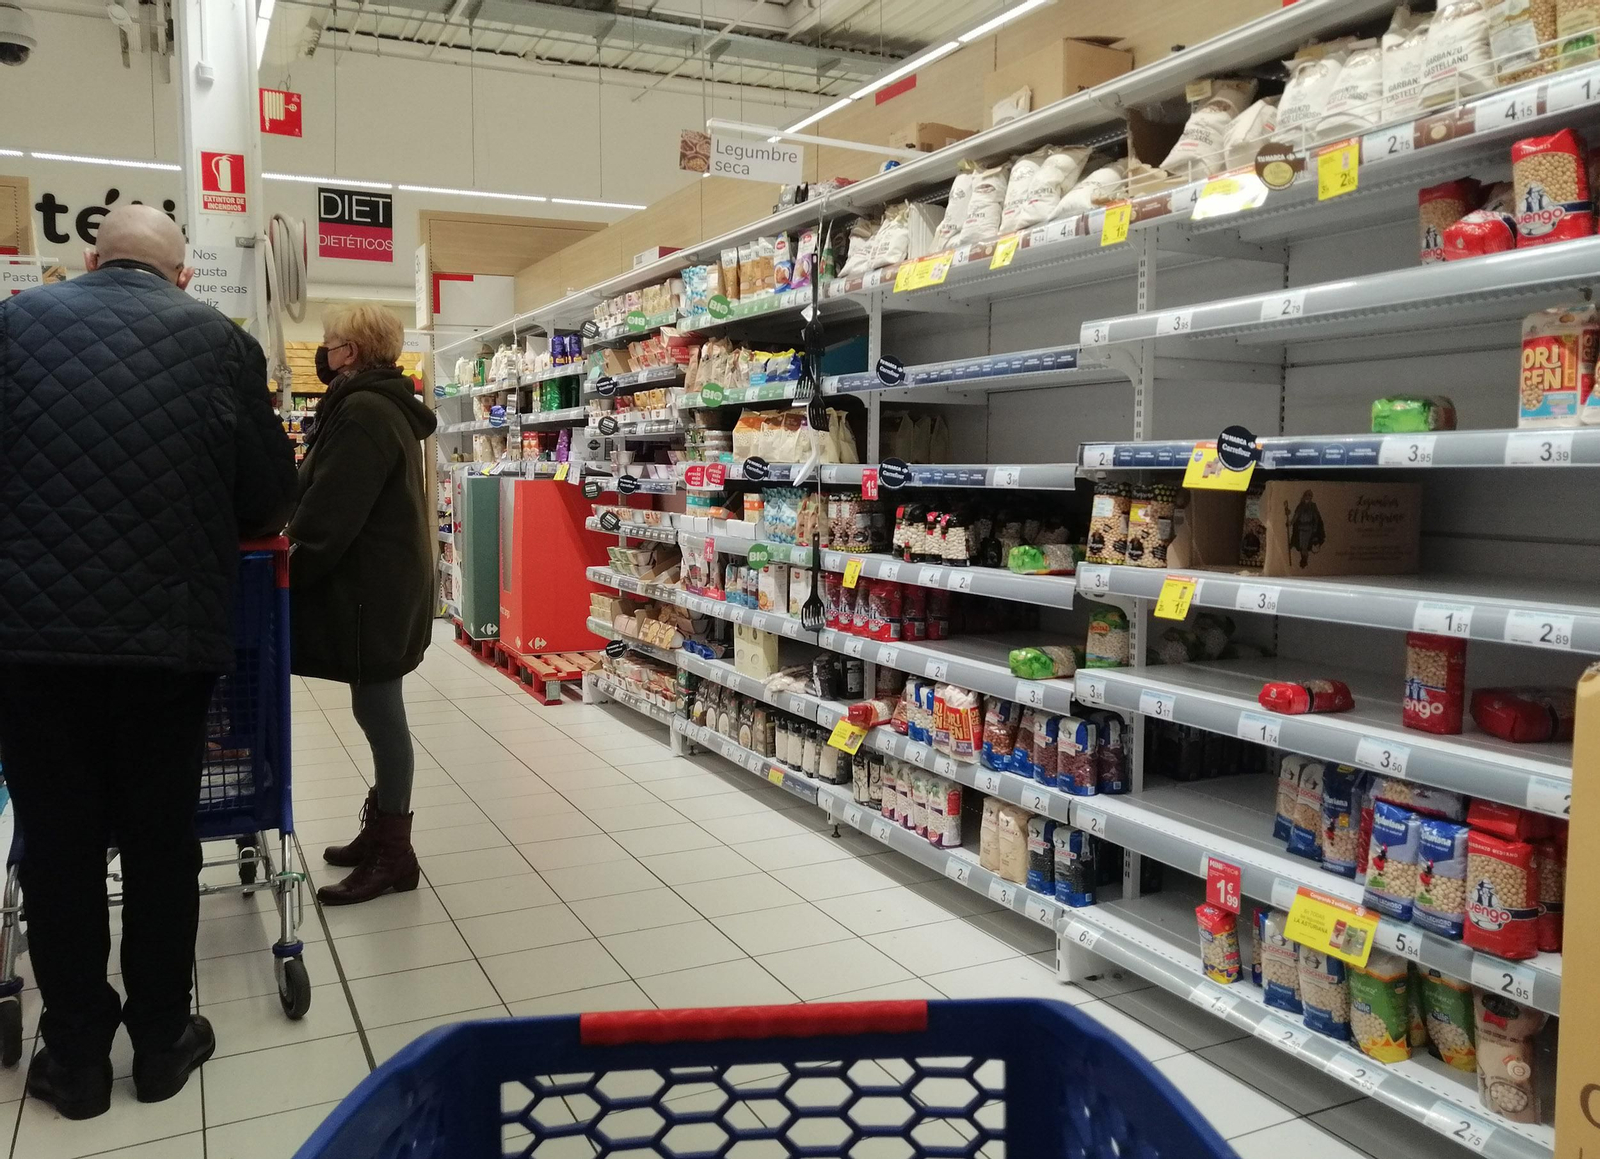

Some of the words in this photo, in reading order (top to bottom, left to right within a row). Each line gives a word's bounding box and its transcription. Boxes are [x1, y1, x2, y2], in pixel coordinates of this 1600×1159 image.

[716, 139, 798, 163] Legumbre
[714, 160, 750, 175] seca
[203, 195, 236, 204] EXTINTOR
[236, 197, 245, 205] DE
[207, 202, 242, 211] INCENDIOS
[319, 191, 391, 223] DIET
[318, 231, 394, 252] DIETÉTICOS
[192, 249, 218, 261] Nos
[2, 271, 39, 283] Pasta
[193, 267, 228, 278] gusta
[194, 284, 218, 293] que
[220, 285, 248, 294] seas
[708, 300, 729, 314] BIO
[1281, 299, 1301, 316] 2,79
[1523, 345, 1562, 369] ORI
[702, 389, 722, 400] BIO
[1228, 434, 1247, 446] MARCA
[1221, 443, 1253, 458] Carrefour
[1407, 443, 1432, 463] 3,95
[1539, 441, 1570, 461] 3,39
[749, 551, 768, 562] BIO
[1444, 612, 1469, 633] 1,87
[1539, 622, 1569, 646] 2,89
[1260, 725, 1278, 744] 1,74
[1379, 750, 1403, 773] 3,50
[1300, 920, 1328, 934] ASTURIANA
[1395, 933, 1419, 957] 5,94
[1501, 972, 1529, 1000] 2,95
[1453, 1120, 1482, 1147] 2,75
